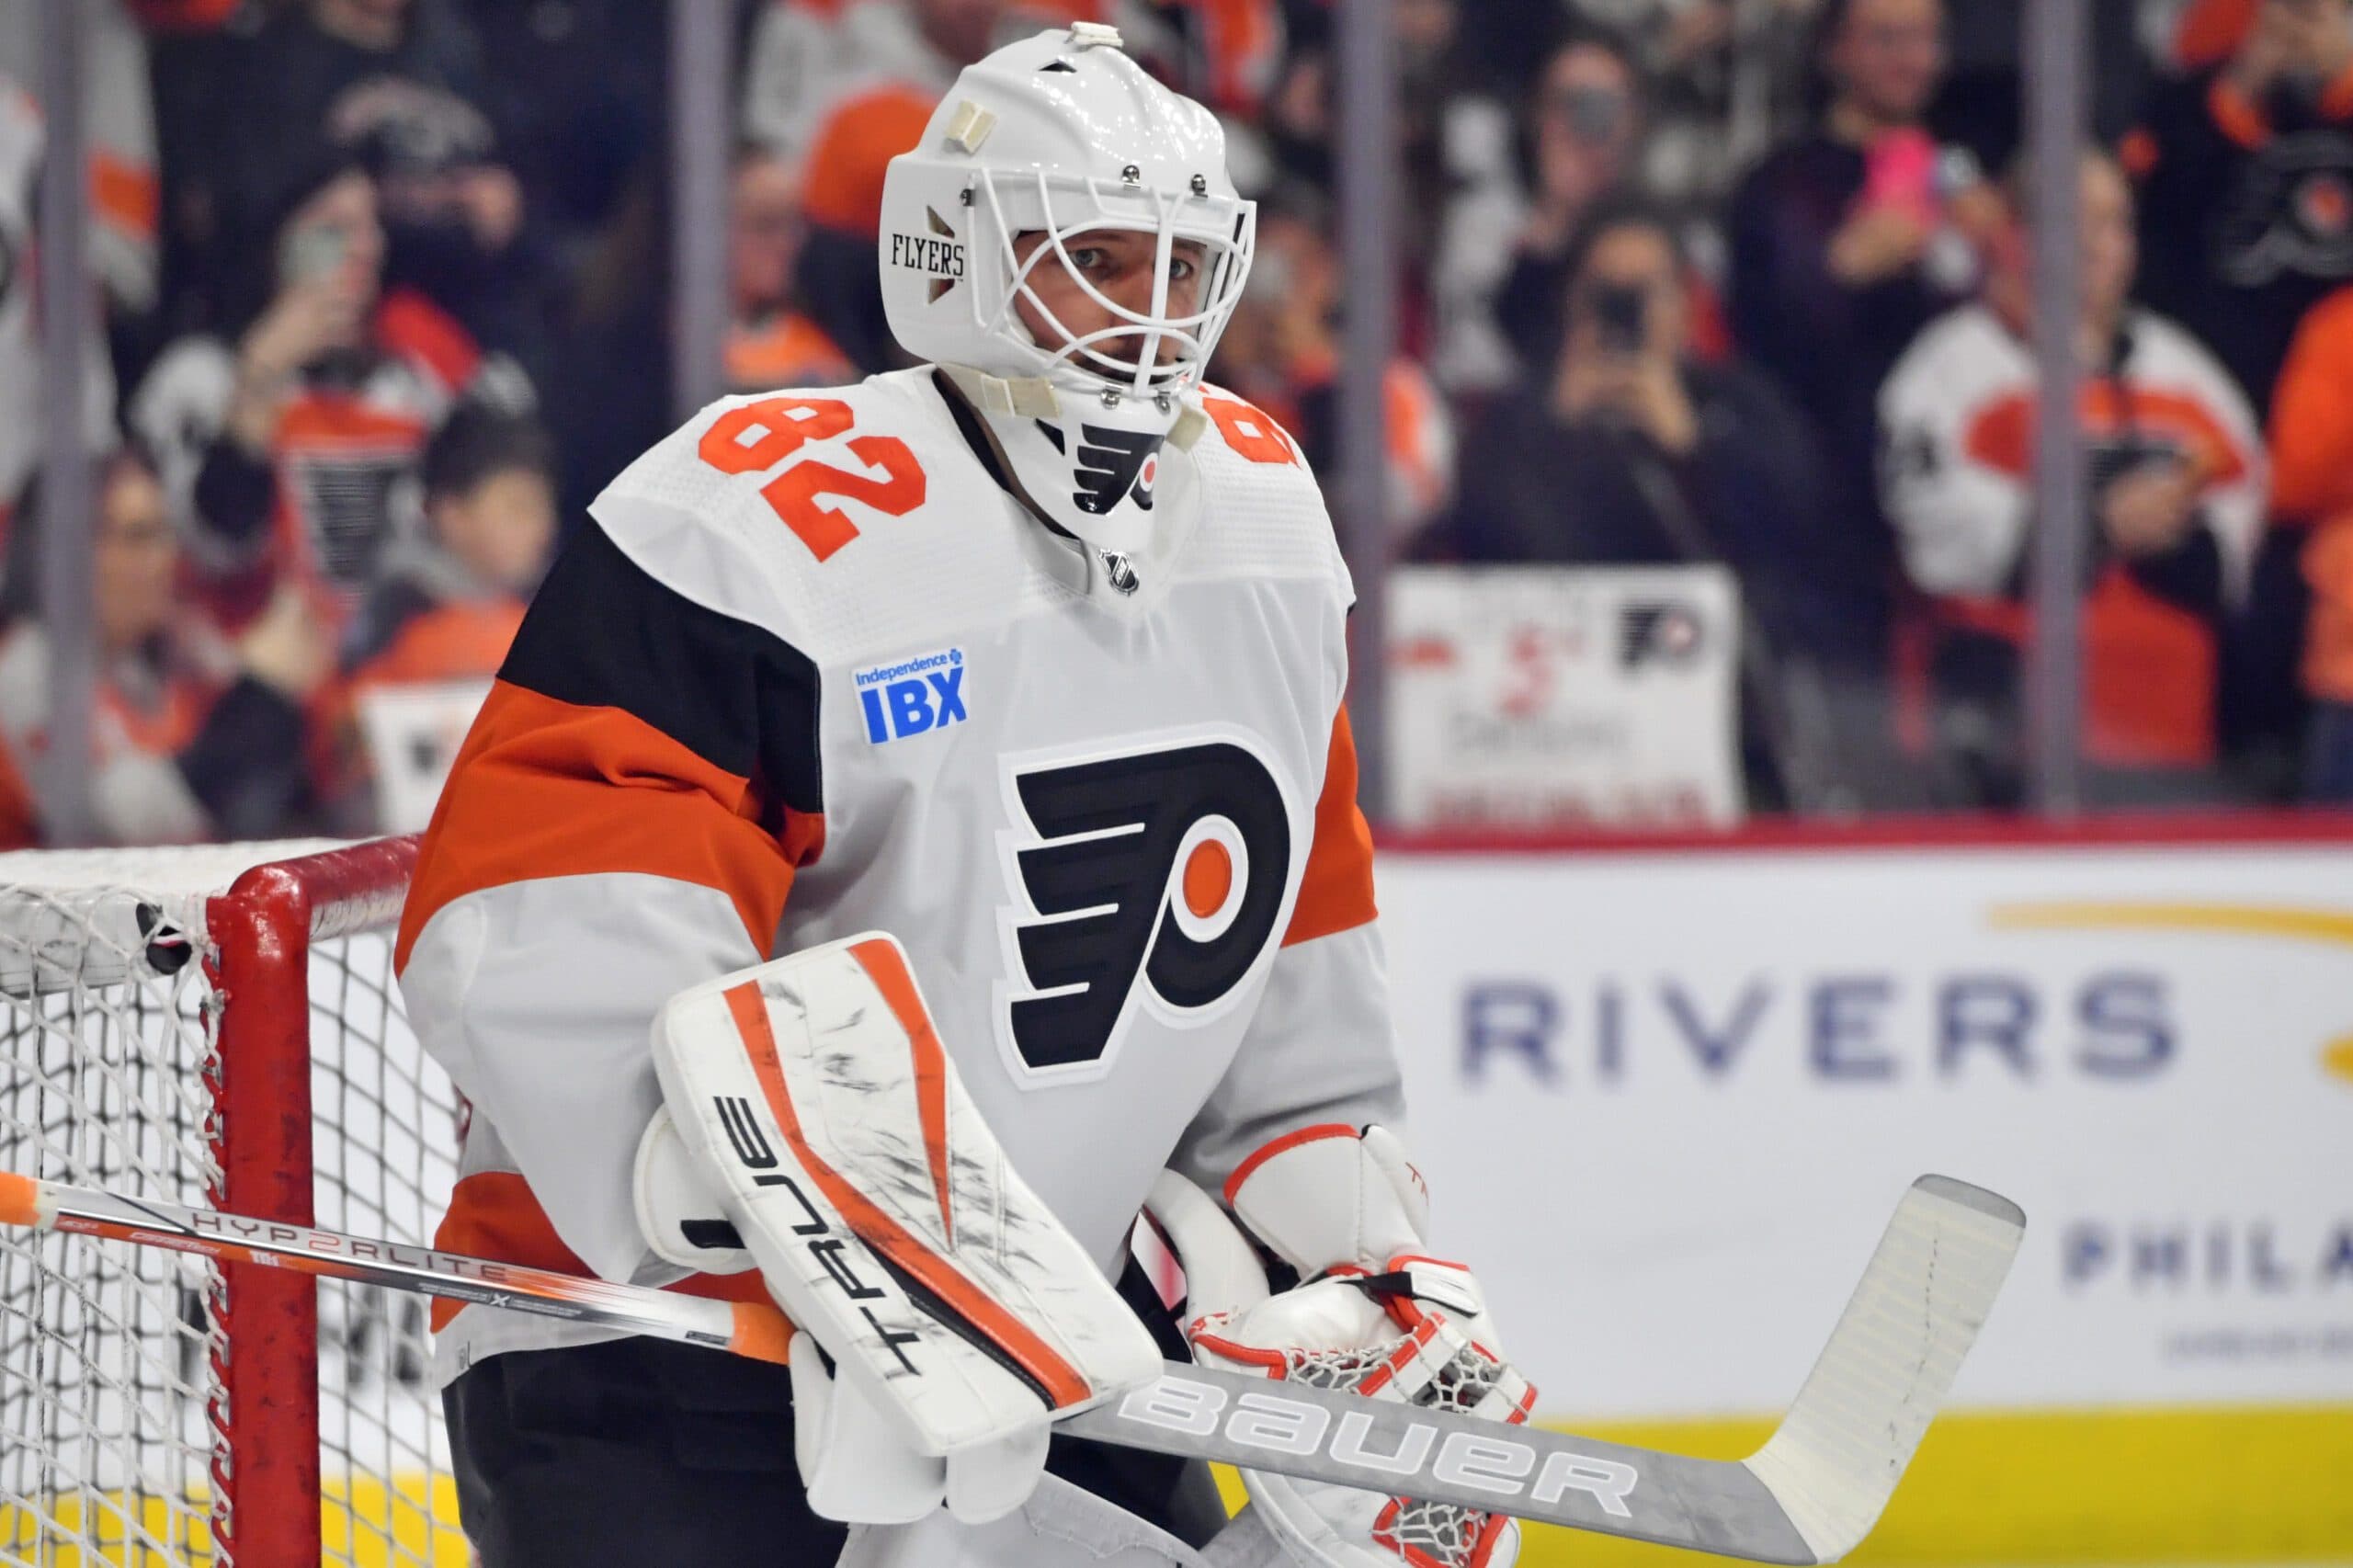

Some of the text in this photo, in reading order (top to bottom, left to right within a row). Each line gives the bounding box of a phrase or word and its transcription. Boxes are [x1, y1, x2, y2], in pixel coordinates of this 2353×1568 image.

[892, 233, 964, 277] FLYERS
[1198, 385, 1303, 471] 8
[699, 397, 926, 563] 82
[855, 653, 948, 687] Independence
[860, 666, 968, 744] IBX
[1459, 971, 2177, 1084] RIVERS
[191, 1211, 508, 1283] HYP2RLITE
[712, 1096, 923, 1380] TRUE
[1117, 1374, 1638, 1518] BAUER
